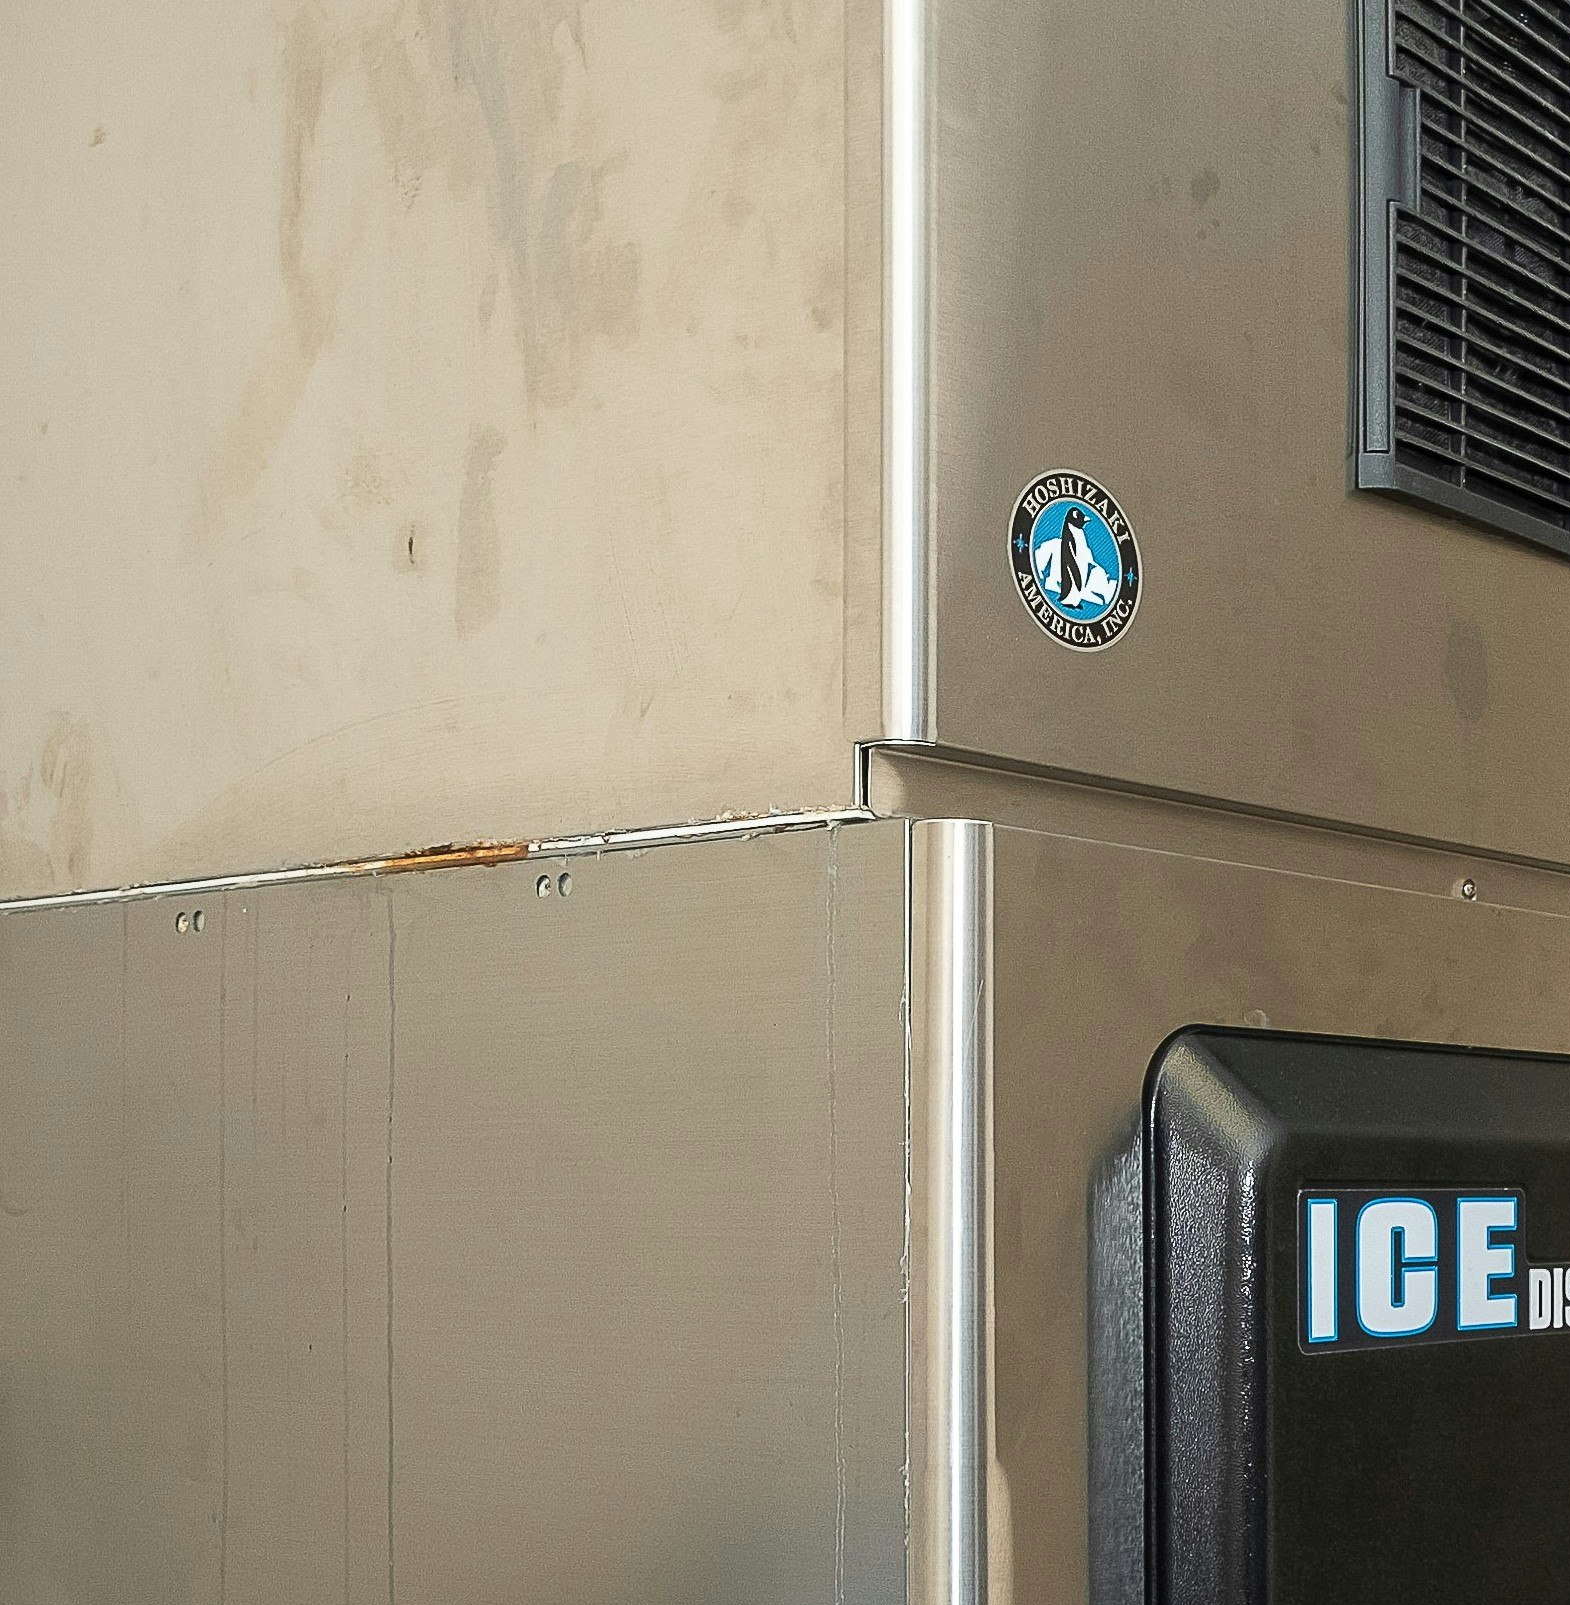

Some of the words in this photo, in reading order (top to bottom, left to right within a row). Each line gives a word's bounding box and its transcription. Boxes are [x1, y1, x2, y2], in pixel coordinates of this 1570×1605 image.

[1021, 477, 1131, 545] HOSHIZAKI
[1018, 571, 1102, 645] AMERICA,
[1101, 599, 1133, 639] INC.
[1307, 1197, 1518, 1343] ICE
